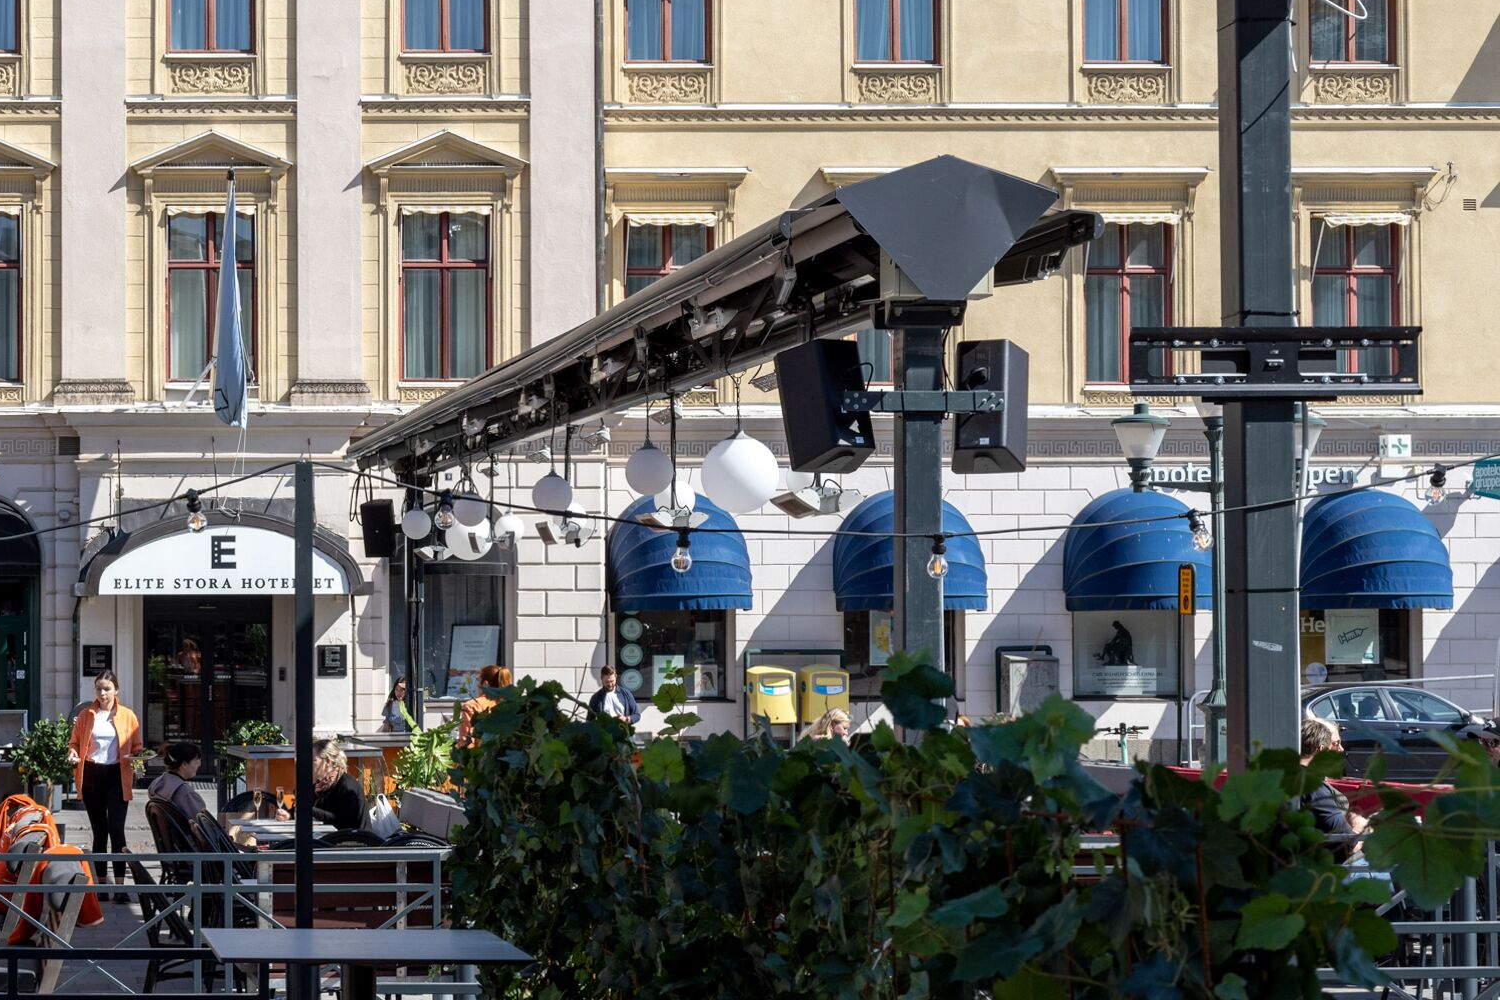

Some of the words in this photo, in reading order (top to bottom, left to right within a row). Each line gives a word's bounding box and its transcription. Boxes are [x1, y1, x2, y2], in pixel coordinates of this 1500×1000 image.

[211, 535, 237, 569] E
[113, 578, 165, 589] ELITE
[173, 578, 232, 589] STORA
[241, 578, 335, 589] HOTEET
[324, 646, 341, 667] E
